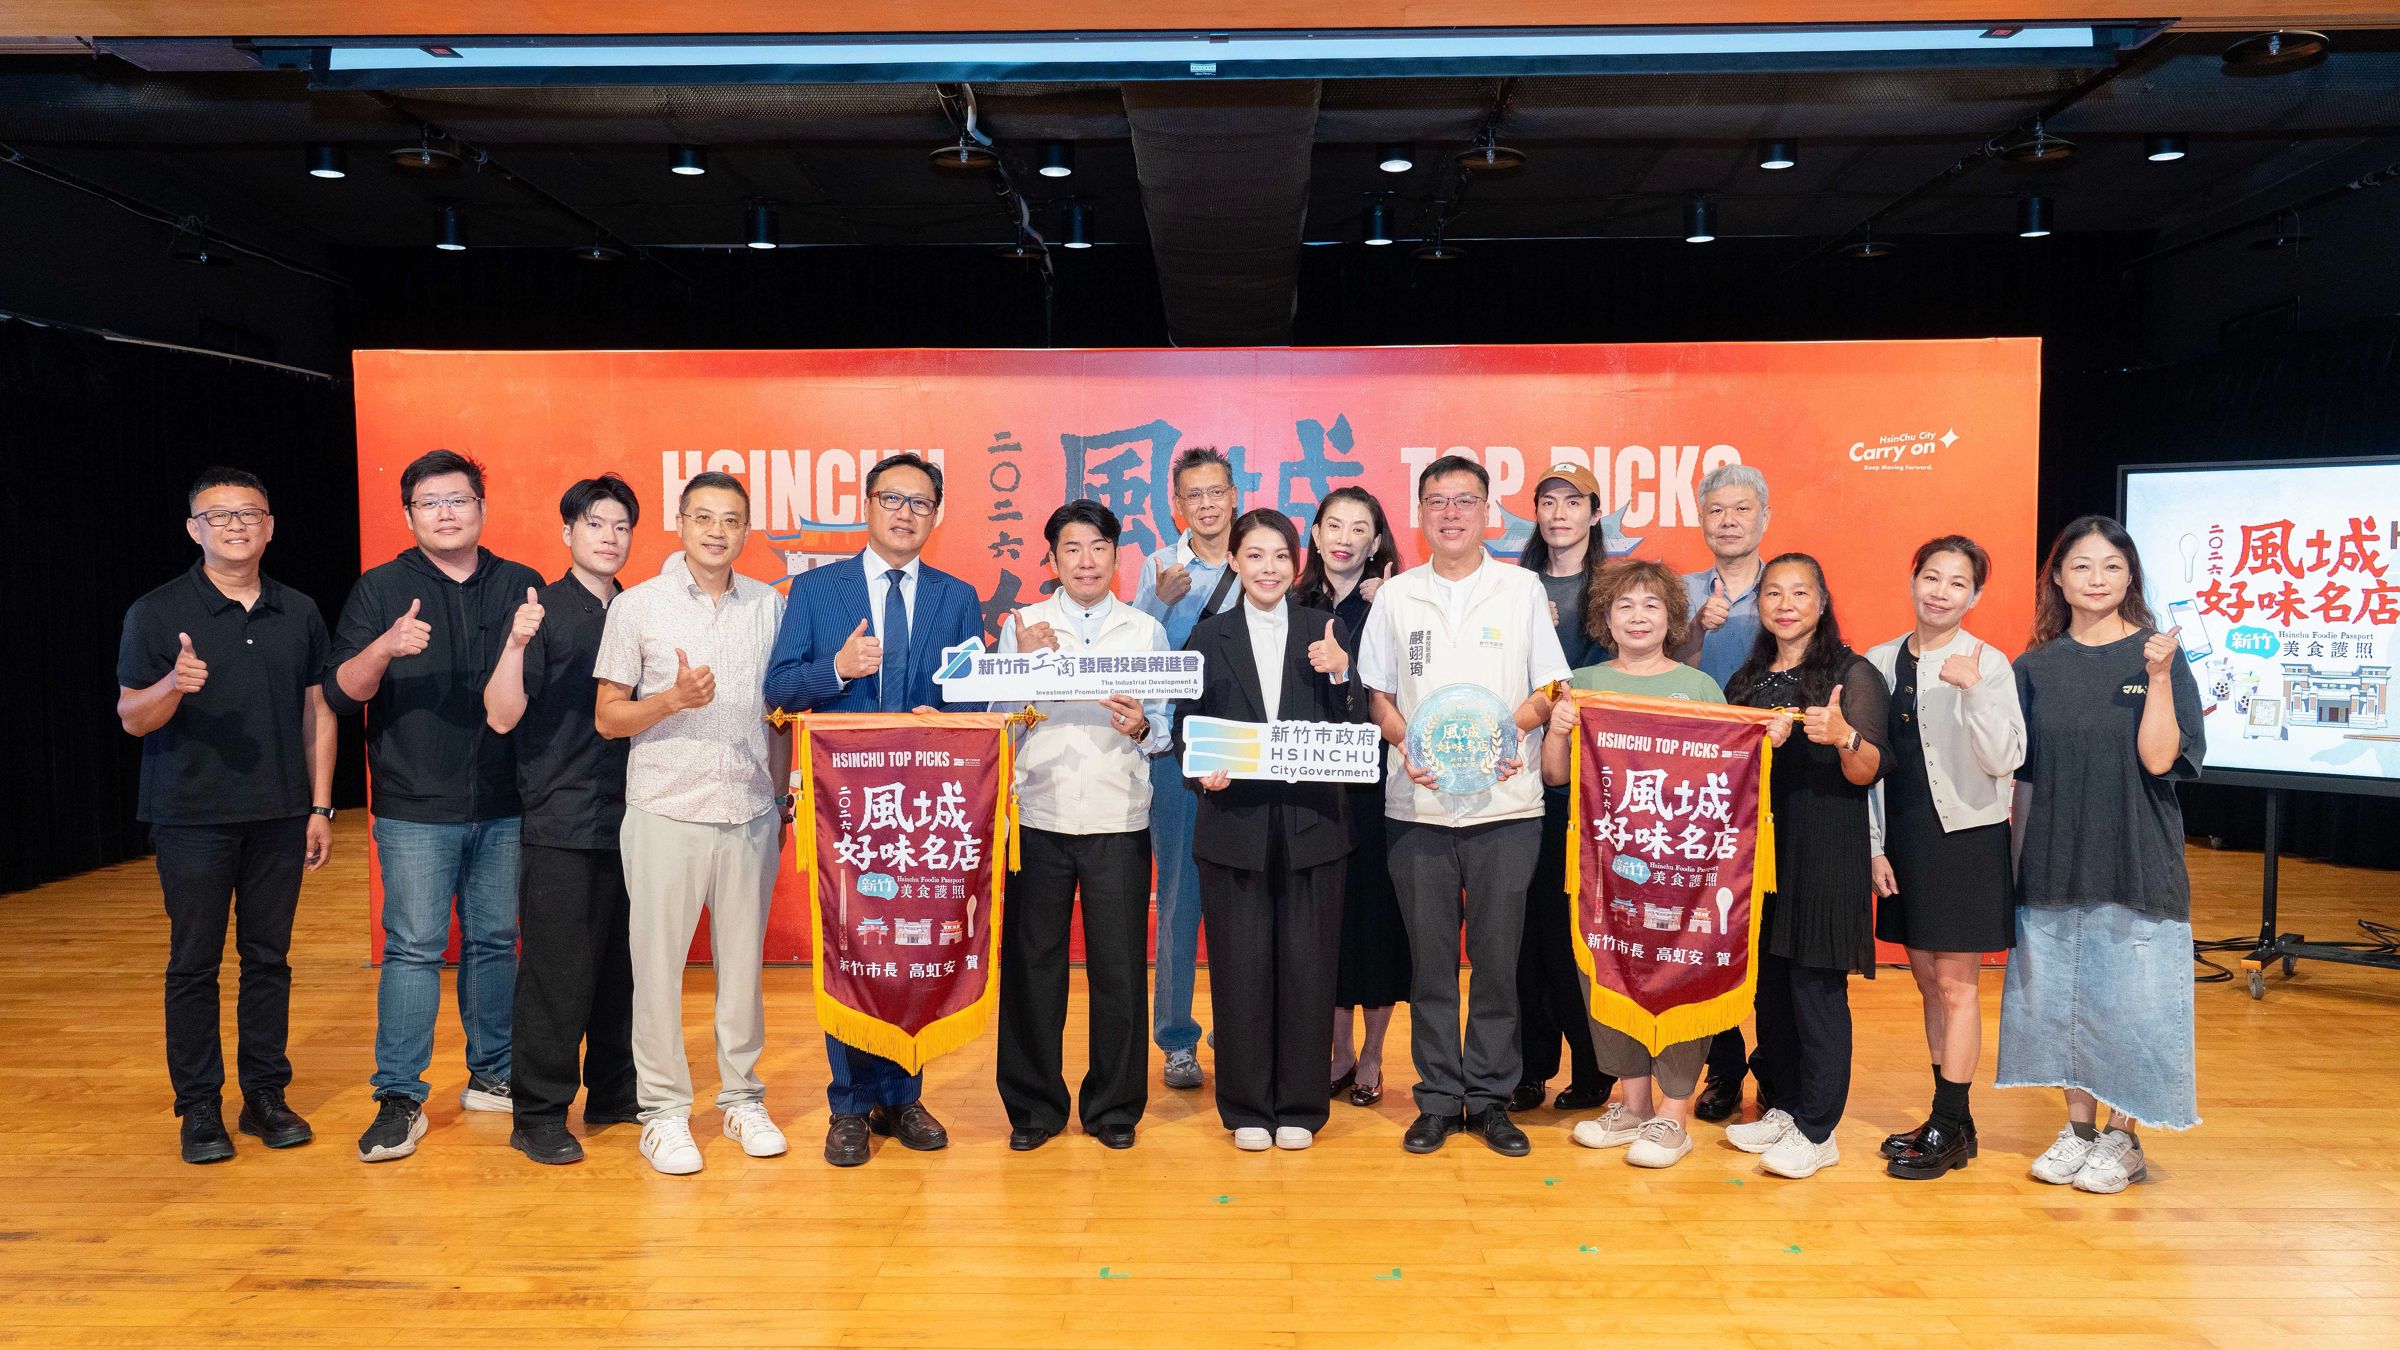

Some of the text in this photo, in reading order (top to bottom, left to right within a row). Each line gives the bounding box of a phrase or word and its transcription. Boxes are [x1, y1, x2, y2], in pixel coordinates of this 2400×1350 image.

[1880, 431, 1937, 444] HsinChu City
[1848, 441, 1936, 462] Carry on
[2230, 515, 2389, 579] 風城
[2196, 578, 2400, 627] 好味名店
[2231, 631, 2273, 650] 新竹
[2278, 631, 2374, 640] Hsinchu Foodie Passport
[2283, 640, 2373, 659] 美食護照
[978, 652, 1199, 677] 新竹市工商發展投資策進會
[1149, 679, 1192, 687] Development
[1184, 687, 1198, 695] City
[1270, 725, 1376, 746] 新竹市政府
[1597, 731, 1651, 752] HSINCHU
[1655, 737, 1679, 755] TOP
[1681, 740, 1720, 759] PICKS
[832, 752, 885, 768] HSINCHU
[888, 751, 912, 767] TOP
[915, 751, 950, 767] PICKS
[1271, 747, 1375, 764] HSINCHU
[1614, 768, 1733, 823] 風城
[856, 780, 973, 833] 風城
[1593, 810, 1740, 861] 好味名店
[833, 832, 983, 873] 好味名店
[1615, 858, 1645, 876] 新竹
[861, 877, 893, 893] 新竹
[1652, 870, 1718, 888] 美食護照
[900, 884, 966, 899] 美食護照
[1587, 932, 1732, 967] 新竹市長 高虹安 賀
[840, 954, 979, 979] 新竹市長 高虹安 賀
